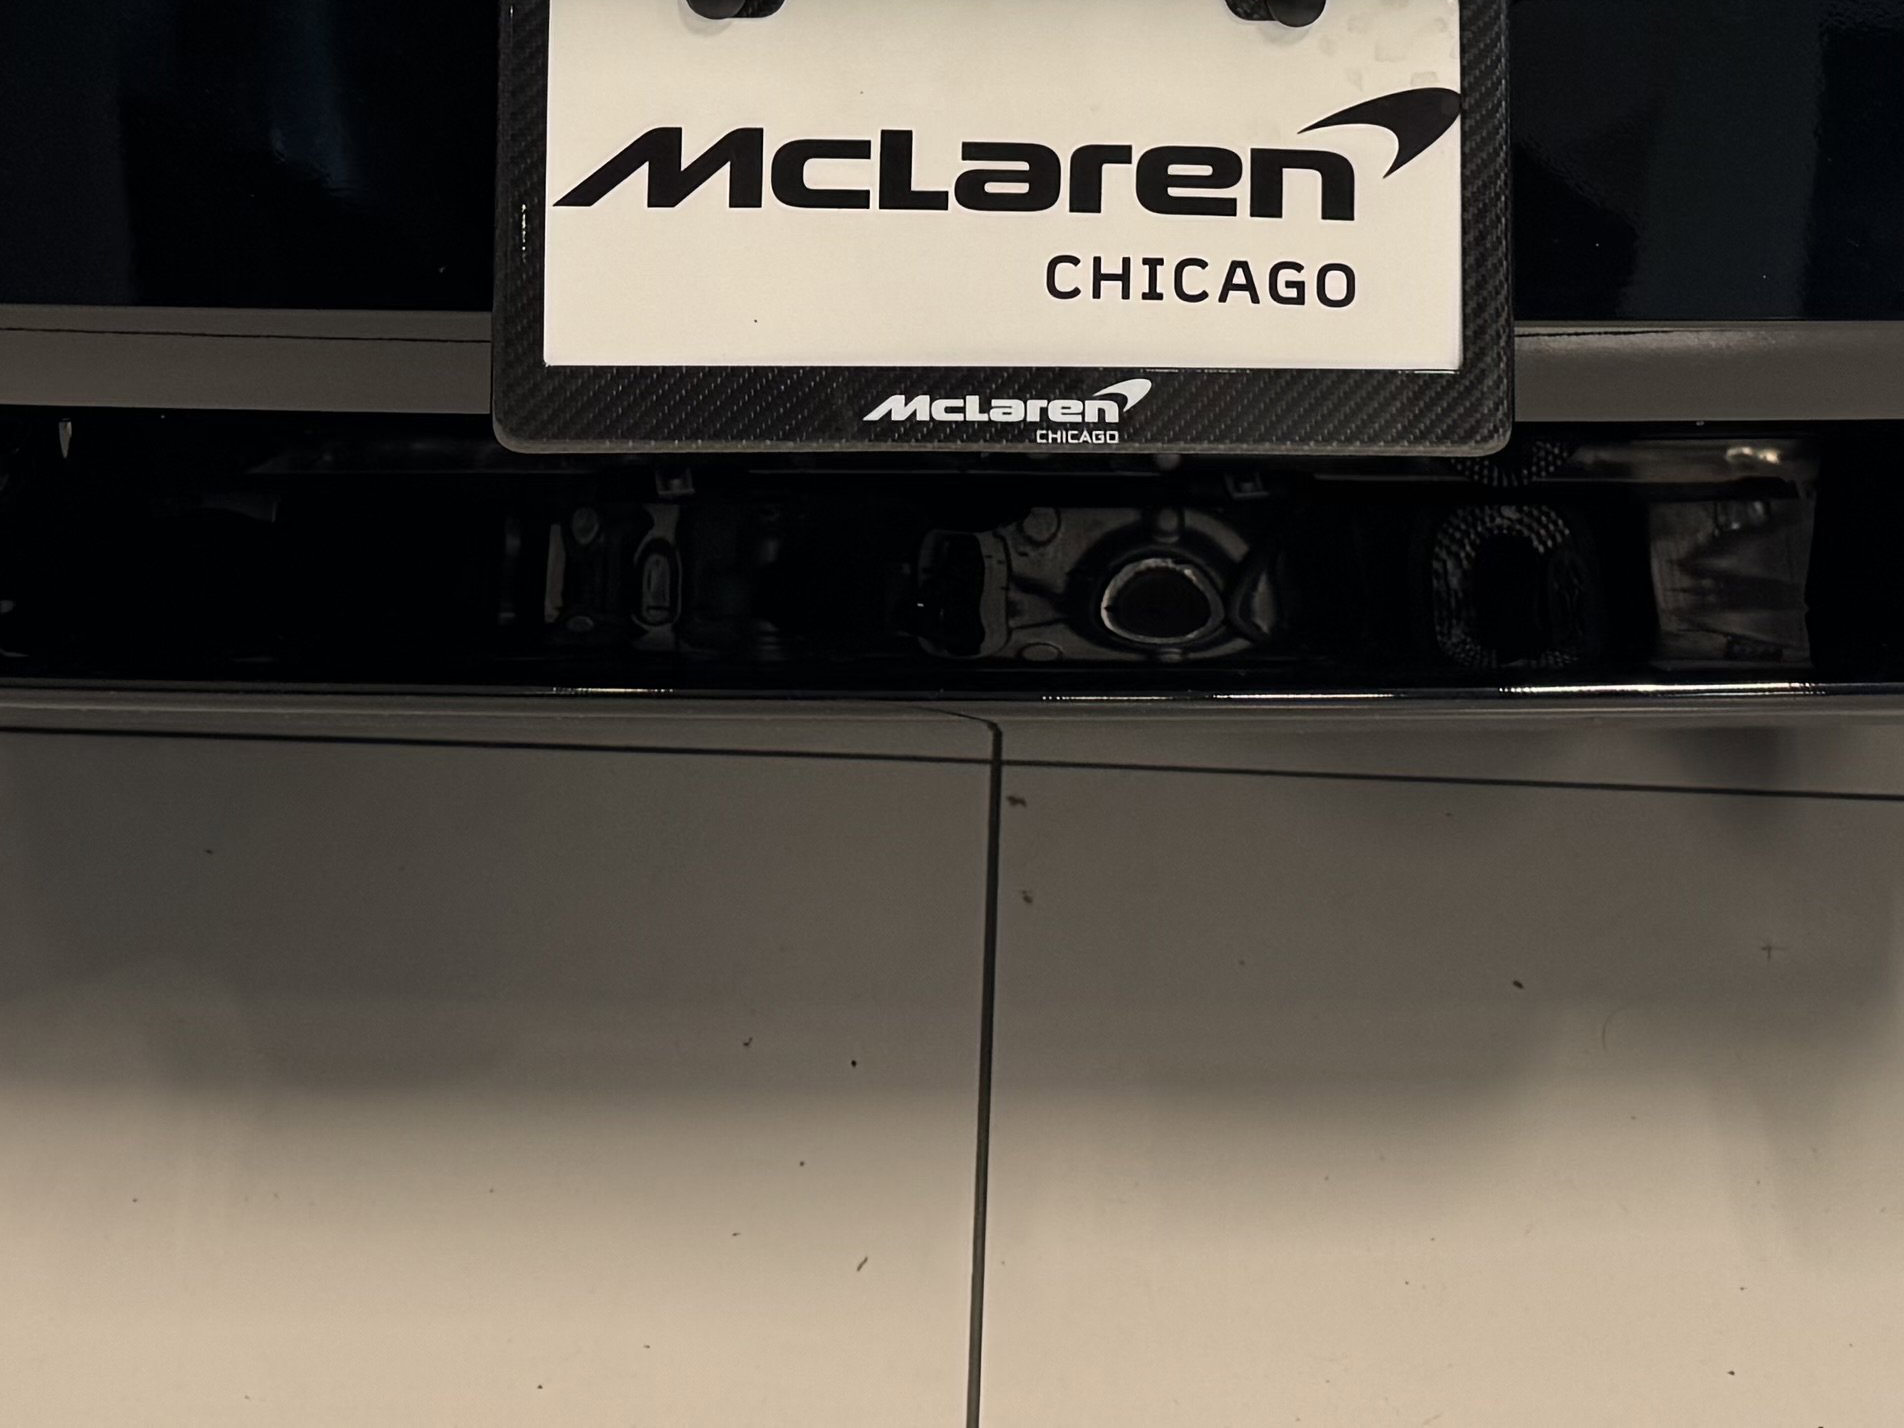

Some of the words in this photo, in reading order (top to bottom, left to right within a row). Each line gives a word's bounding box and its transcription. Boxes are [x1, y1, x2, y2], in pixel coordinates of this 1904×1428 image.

[553, 125, 1356, 221] McLaren
[1045, 253, 1356, 308] CHICAGO
[863, 394, 1120, 423] McLaren
[1036, 430, 1119, 444] CHICAGO
